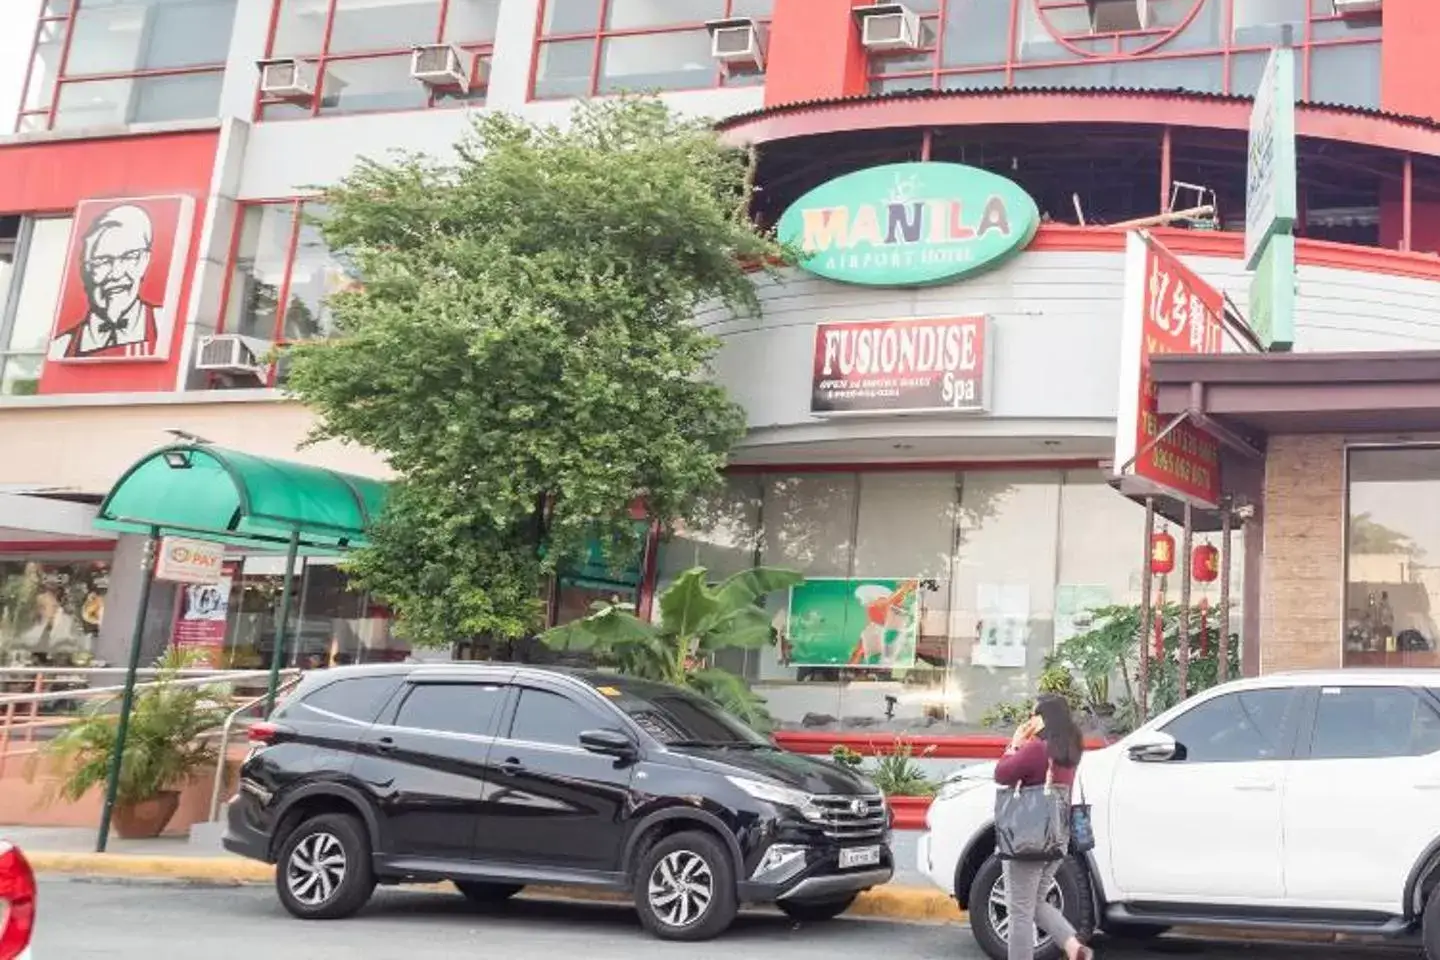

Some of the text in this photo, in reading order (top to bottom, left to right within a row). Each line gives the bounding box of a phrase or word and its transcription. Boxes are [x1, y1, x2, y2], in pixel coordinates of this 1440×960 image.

[802, 194, 1010, 251] MANILA
[826, 247, 975, 270] AIRPORT HOTEL
[823, 324, 976, 375] FUSIONDISE
[942, 372, 975, 408] Spa
